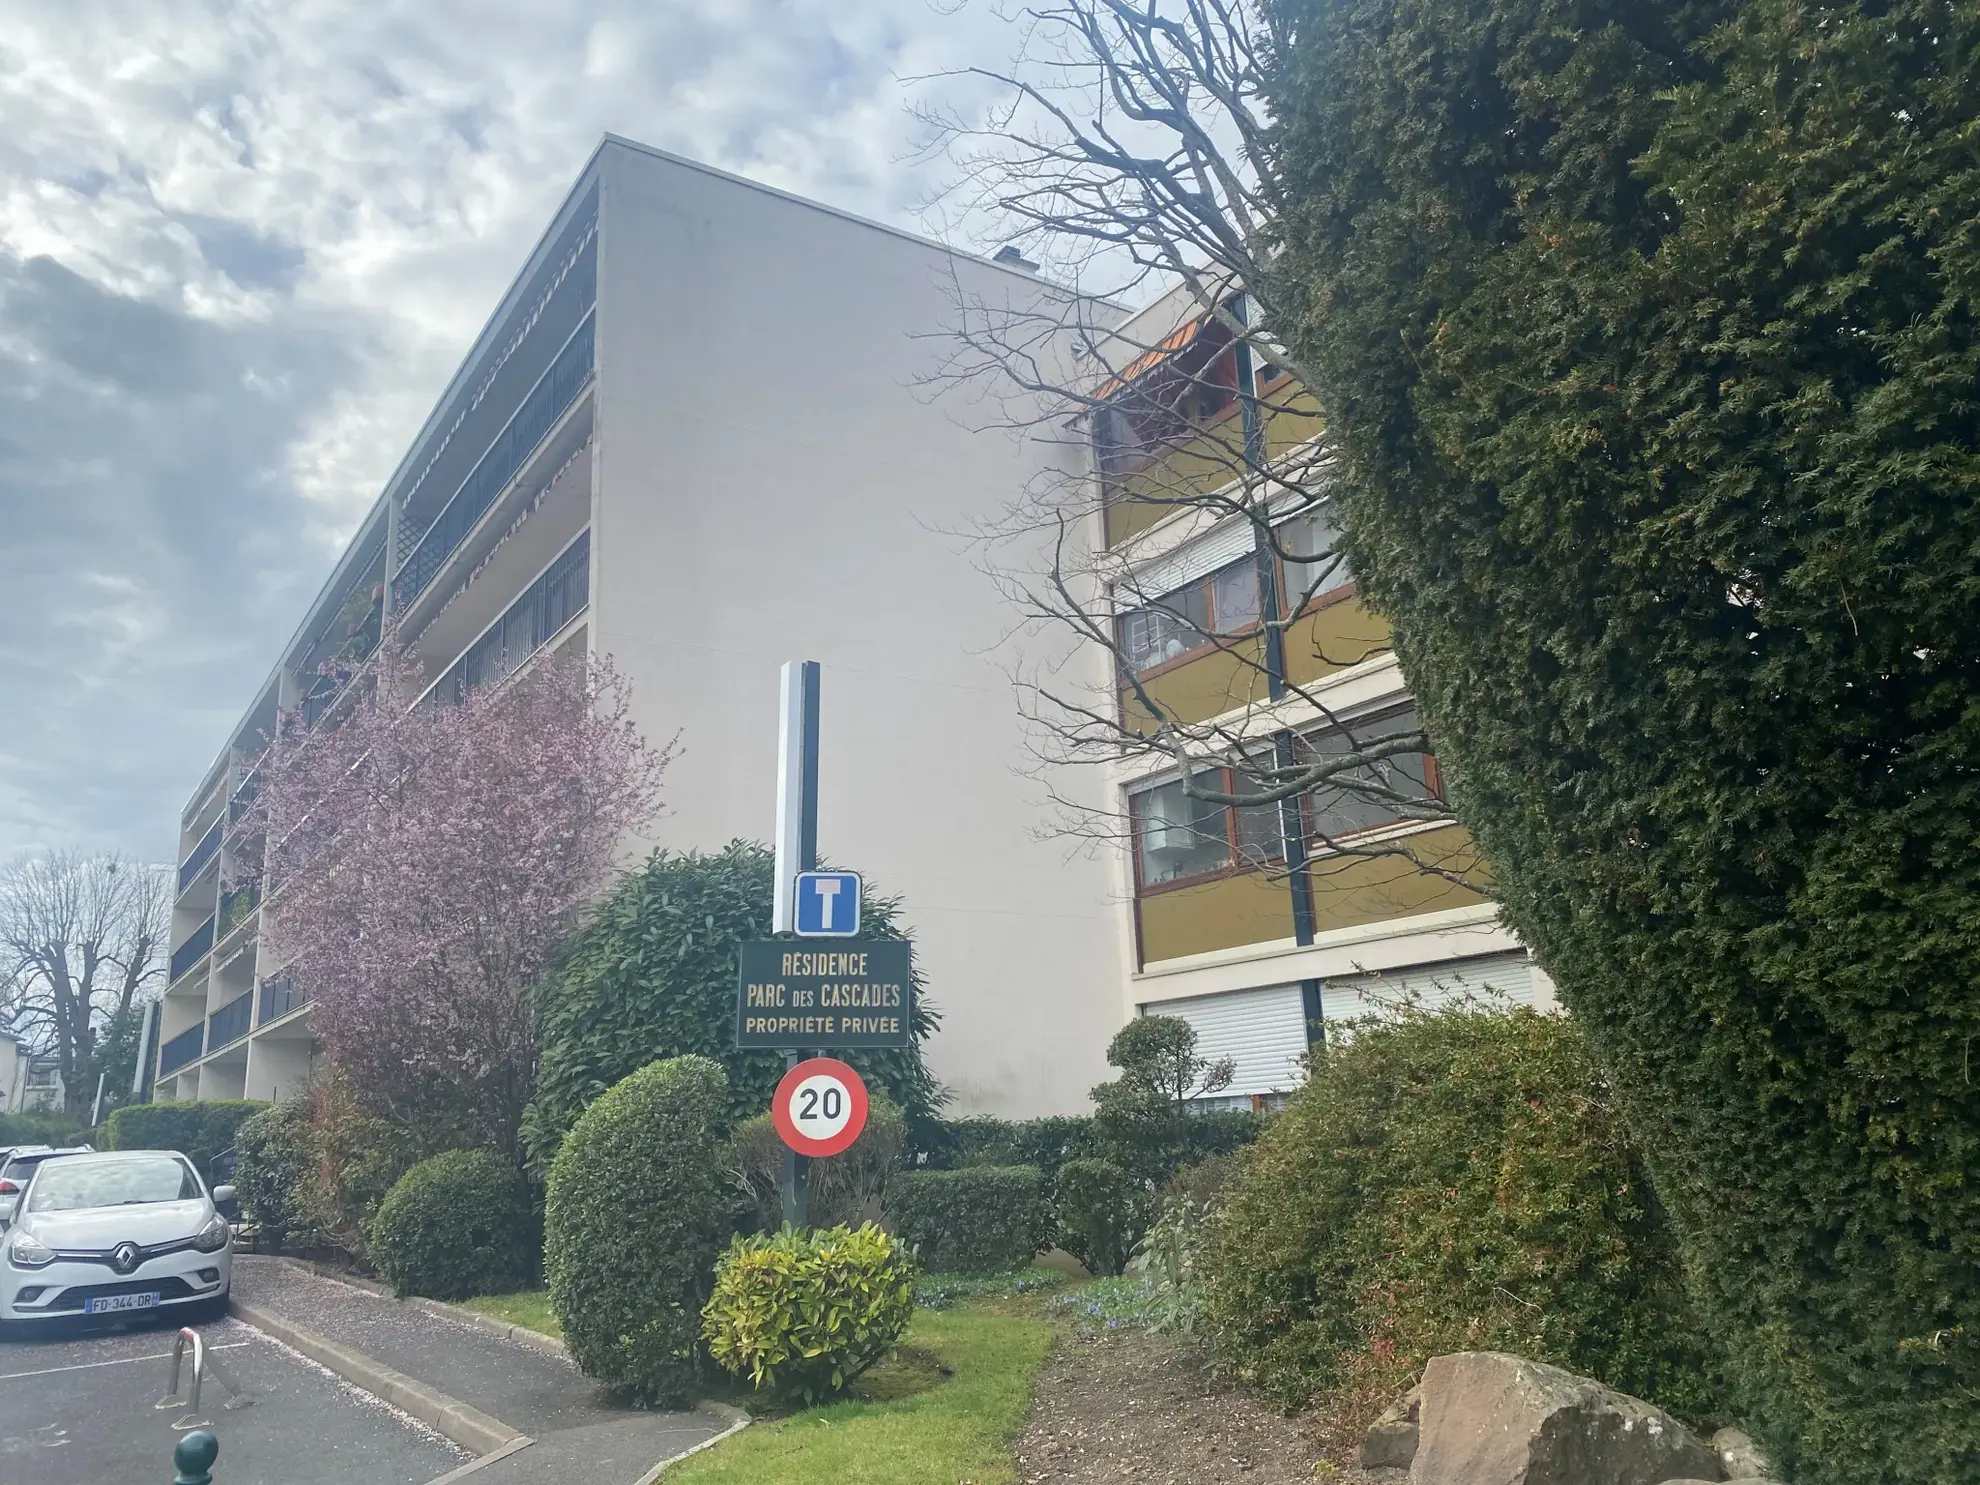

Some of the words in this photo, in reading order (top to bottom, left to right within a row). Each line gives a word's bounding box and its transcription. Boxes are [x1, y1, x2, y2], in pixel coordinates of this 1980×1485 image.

[747, 984, 786, 1007] PARC
[792, 990, 814, 1007] DES
[821, 984, 900, 1007] CASCADES
[745, 1016, 834, 1034] PROPRIÉTÉ
[842, 1016, 900, 1034] PRIVÉE
[799, 1088, 841, 1120] 20
